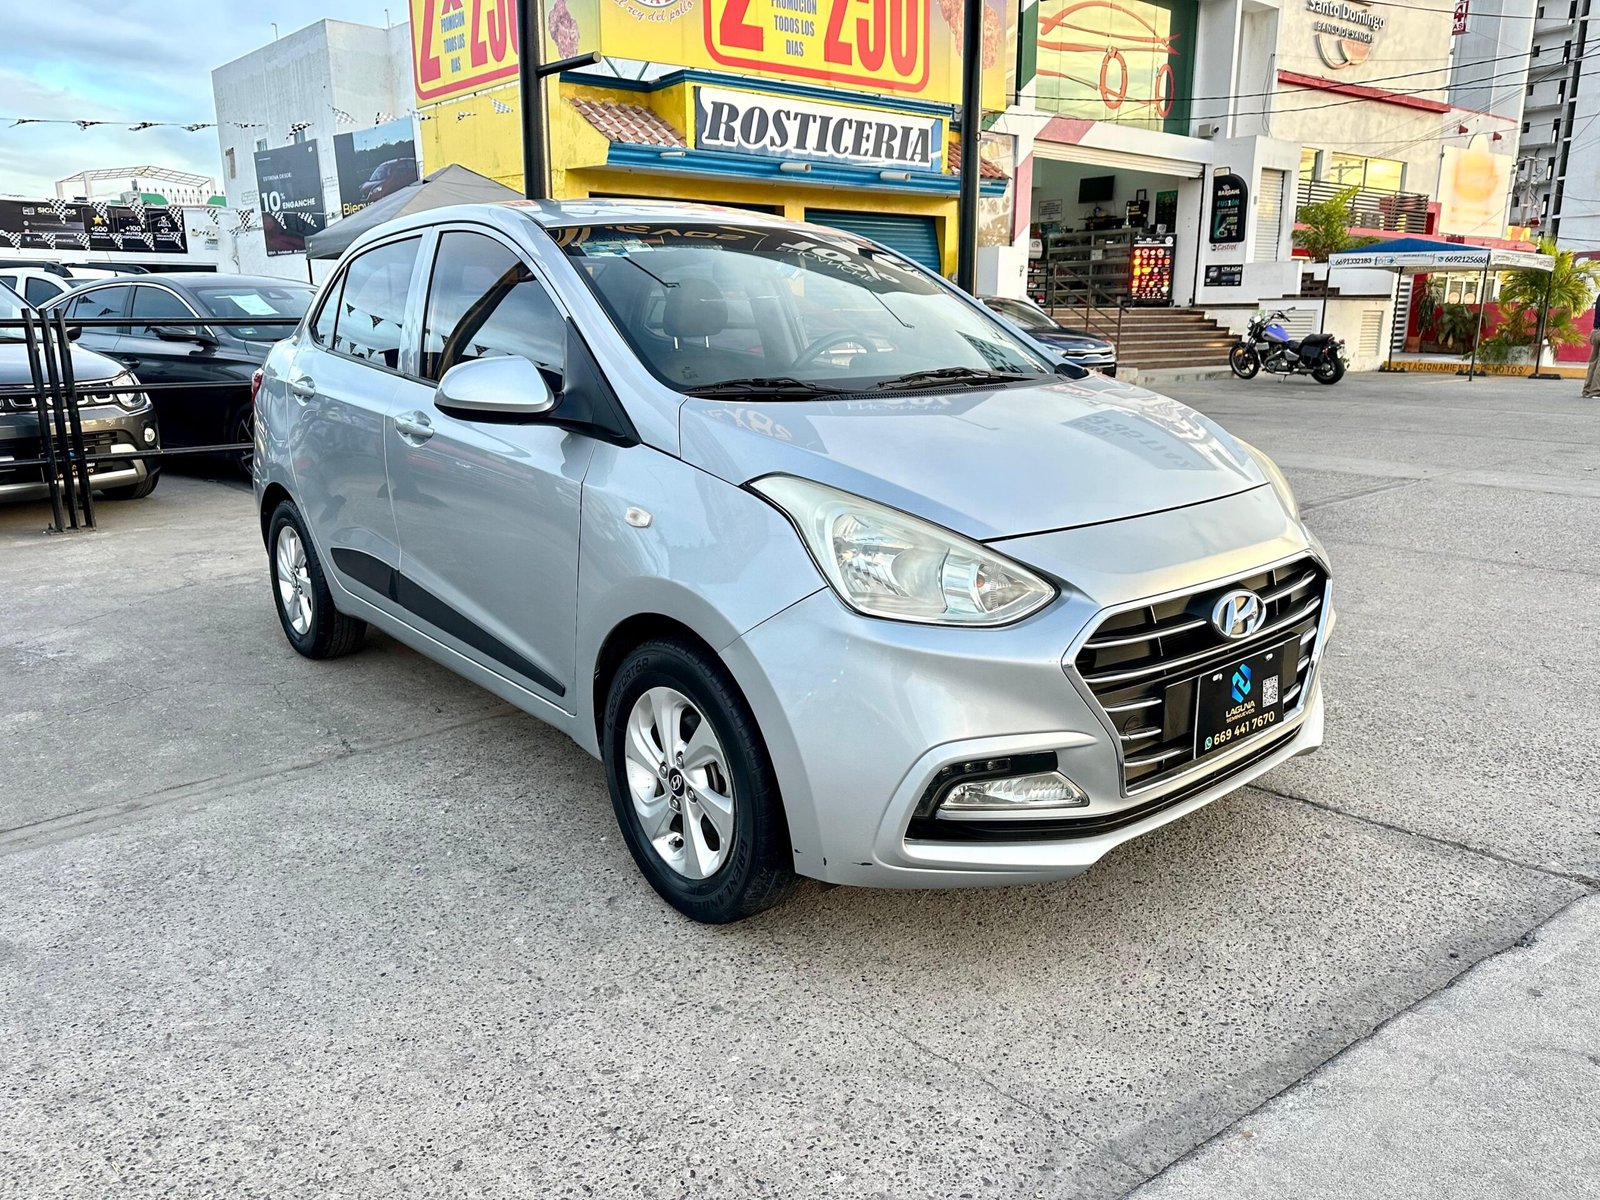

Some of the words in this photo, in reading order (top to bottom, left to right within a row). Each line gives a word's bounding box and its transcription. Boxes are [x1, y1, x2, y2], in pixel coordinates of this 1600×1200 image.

[774, 15, 800, 34] TODOS
[801, 19, 815, 37] LOS
[1342, 4, 1385, 31] Domingo
[786, 39, 804, 57] DIAS
[705, 101, 930, 163] ROSTICERIA
[37, 206, 77, 215] SIGUOS
[282, 197, 316, 209] ENGANCHE
[1396, 361, 1471, 373] ESTACIONAMIENT
[1225, 700, 1256, 718] LAGUNA
[1213, 728, 1232, 745] 669
[1234, 721, 1250, 736] 441
[1251, 710, 1275, 730] 7670
